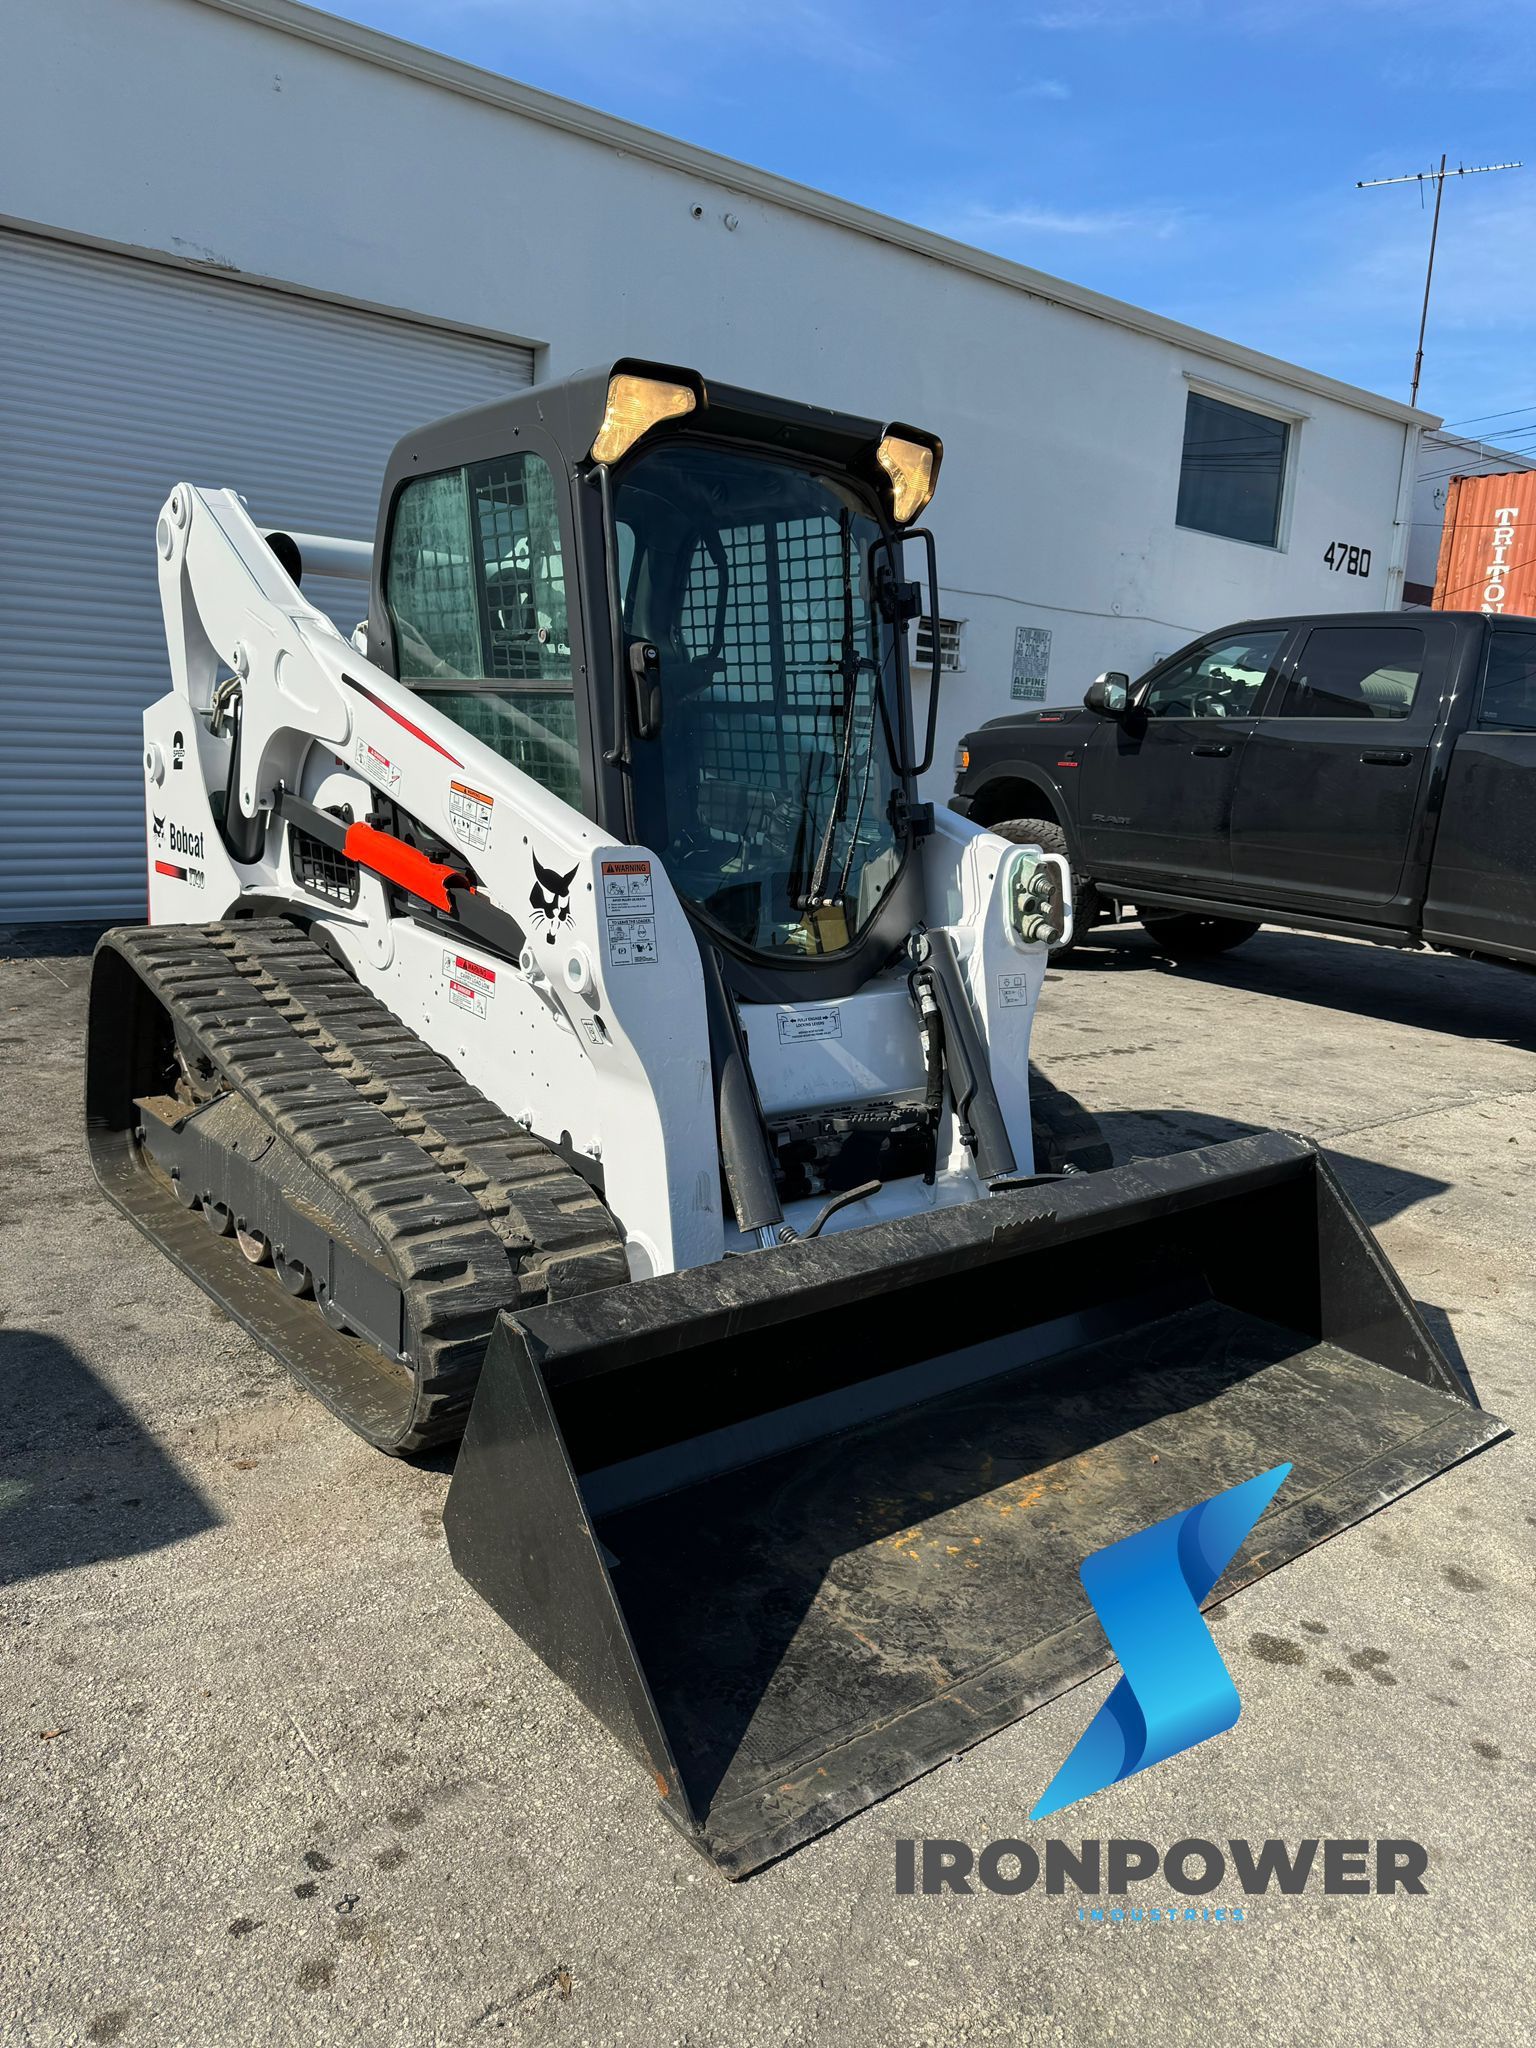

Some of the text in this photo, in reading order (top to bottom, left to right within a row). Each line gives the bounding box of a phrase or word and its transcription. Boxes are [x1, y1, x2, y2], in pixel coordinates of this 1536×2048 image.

[1324, 541, 1372, 578] 4780
[1013, 677, 1046, 686] ALPINE
[1092, 813, 1132, 825] RAM
[169, 822, 205, 860] Bobcat
[614, 863, 647, 873] WARNING
